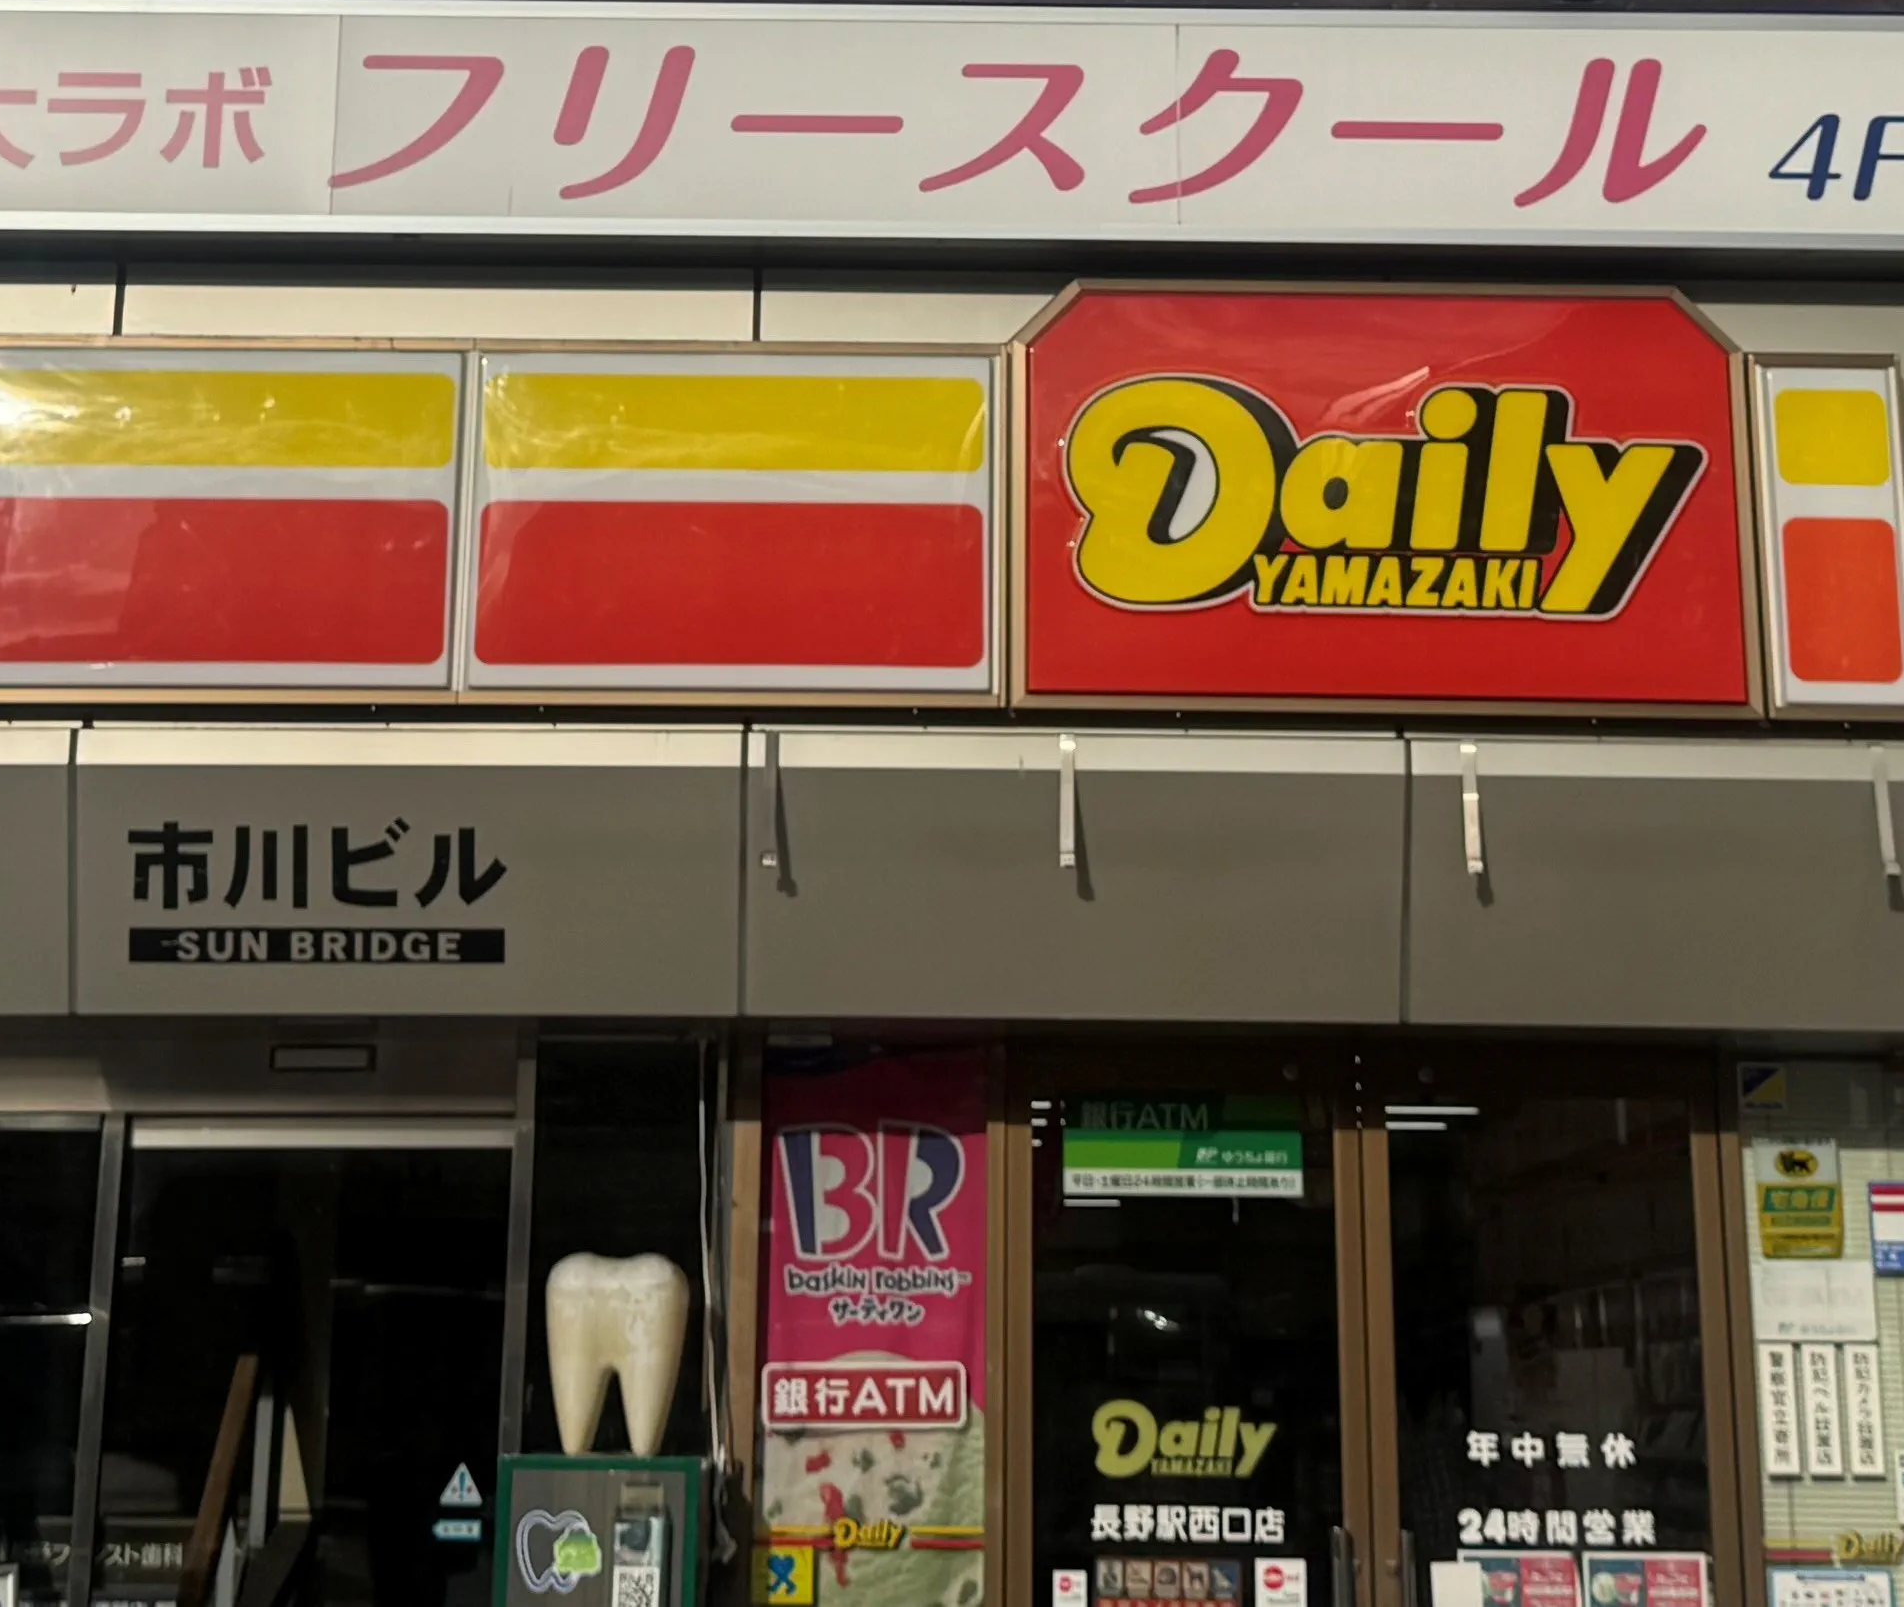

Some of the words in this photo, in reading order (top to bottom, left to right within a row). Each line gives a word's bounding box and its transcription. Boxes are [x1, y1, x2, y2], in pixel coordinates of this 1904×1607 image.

[329, 44, 1709, 209] フリースクール
[1064, 370, 1710, 623] Daily
[1253, 551, 1542, 611] YAMAZAKI
[127, 816, 508, 911] 市川ビル
[175, 930, 270, 962] SUN
[289, 931, 463, 963] BRIDGE
[785, 1265, 867, 1294] baskin
[873, 1267, 959, 1295] robbins
[773, 1376, 955, 1417] 銀行ATM
[1091, 1397, 1281, 1480] Daily
[1466, 1429, 1638, 1469] 年中無休
[833, 1518, 911, 1550] Daily
[1089, 1503, 1288, 1544] 長野駅西口店
[1456, 1506, 1657, 1545] 24時間営業
